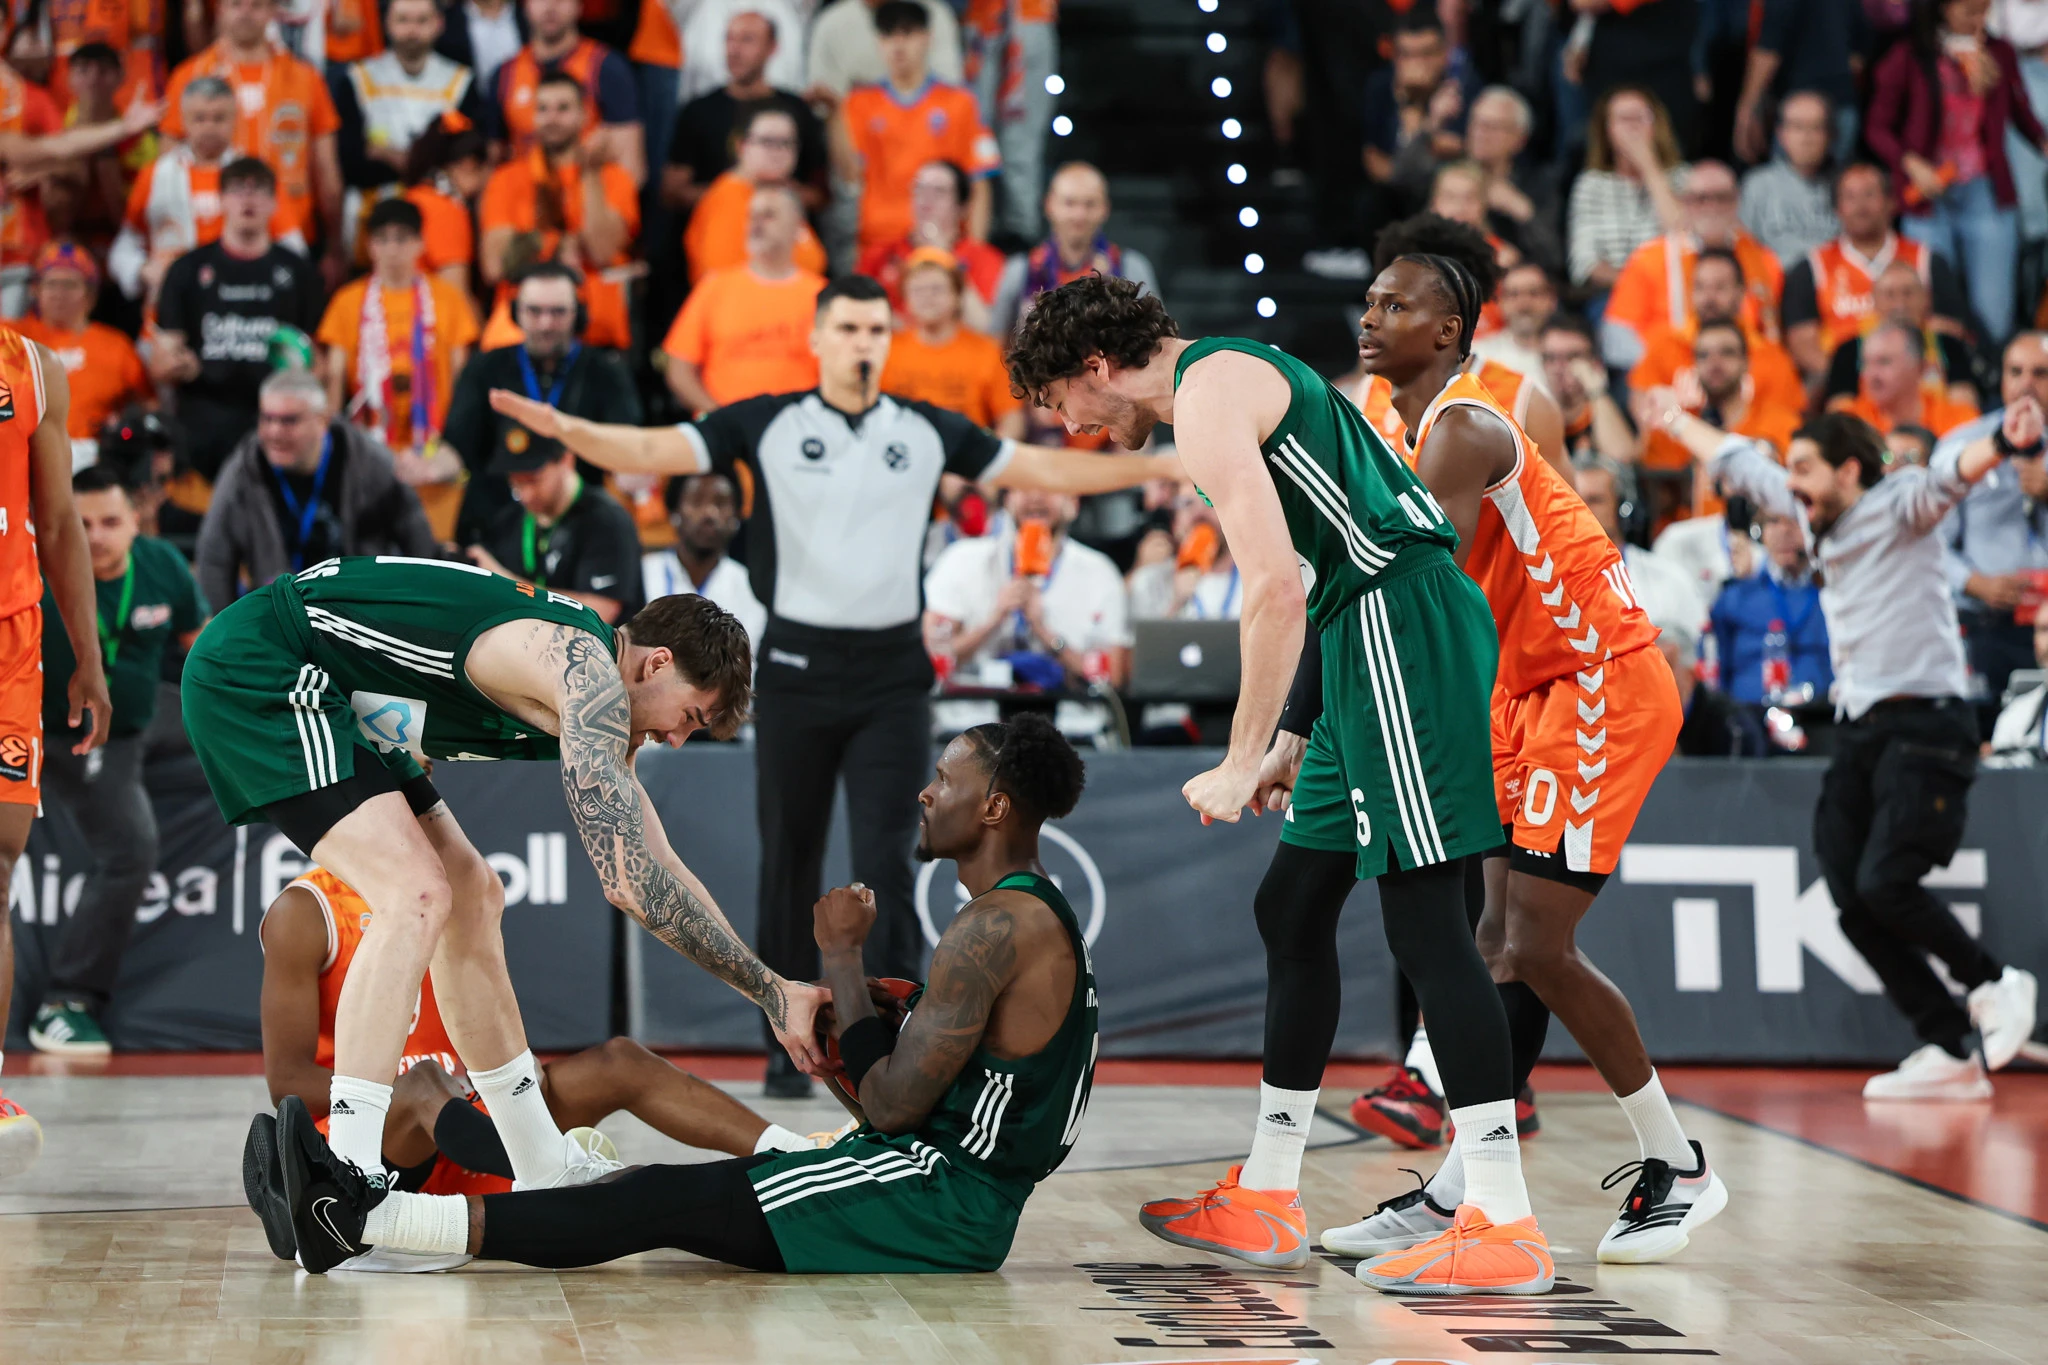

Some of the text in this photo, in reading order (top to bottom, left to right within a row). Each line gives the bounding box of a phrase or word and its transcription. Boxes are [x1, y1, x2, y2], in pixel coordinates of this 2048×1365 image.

[1523, 768, 1558, 826] 0
[1265, 1115, 1297, 1128] adidas
[1480, 1133, 1515, 1142] adidas
[1072, 1262, 1336, 1349] EuroLeague
